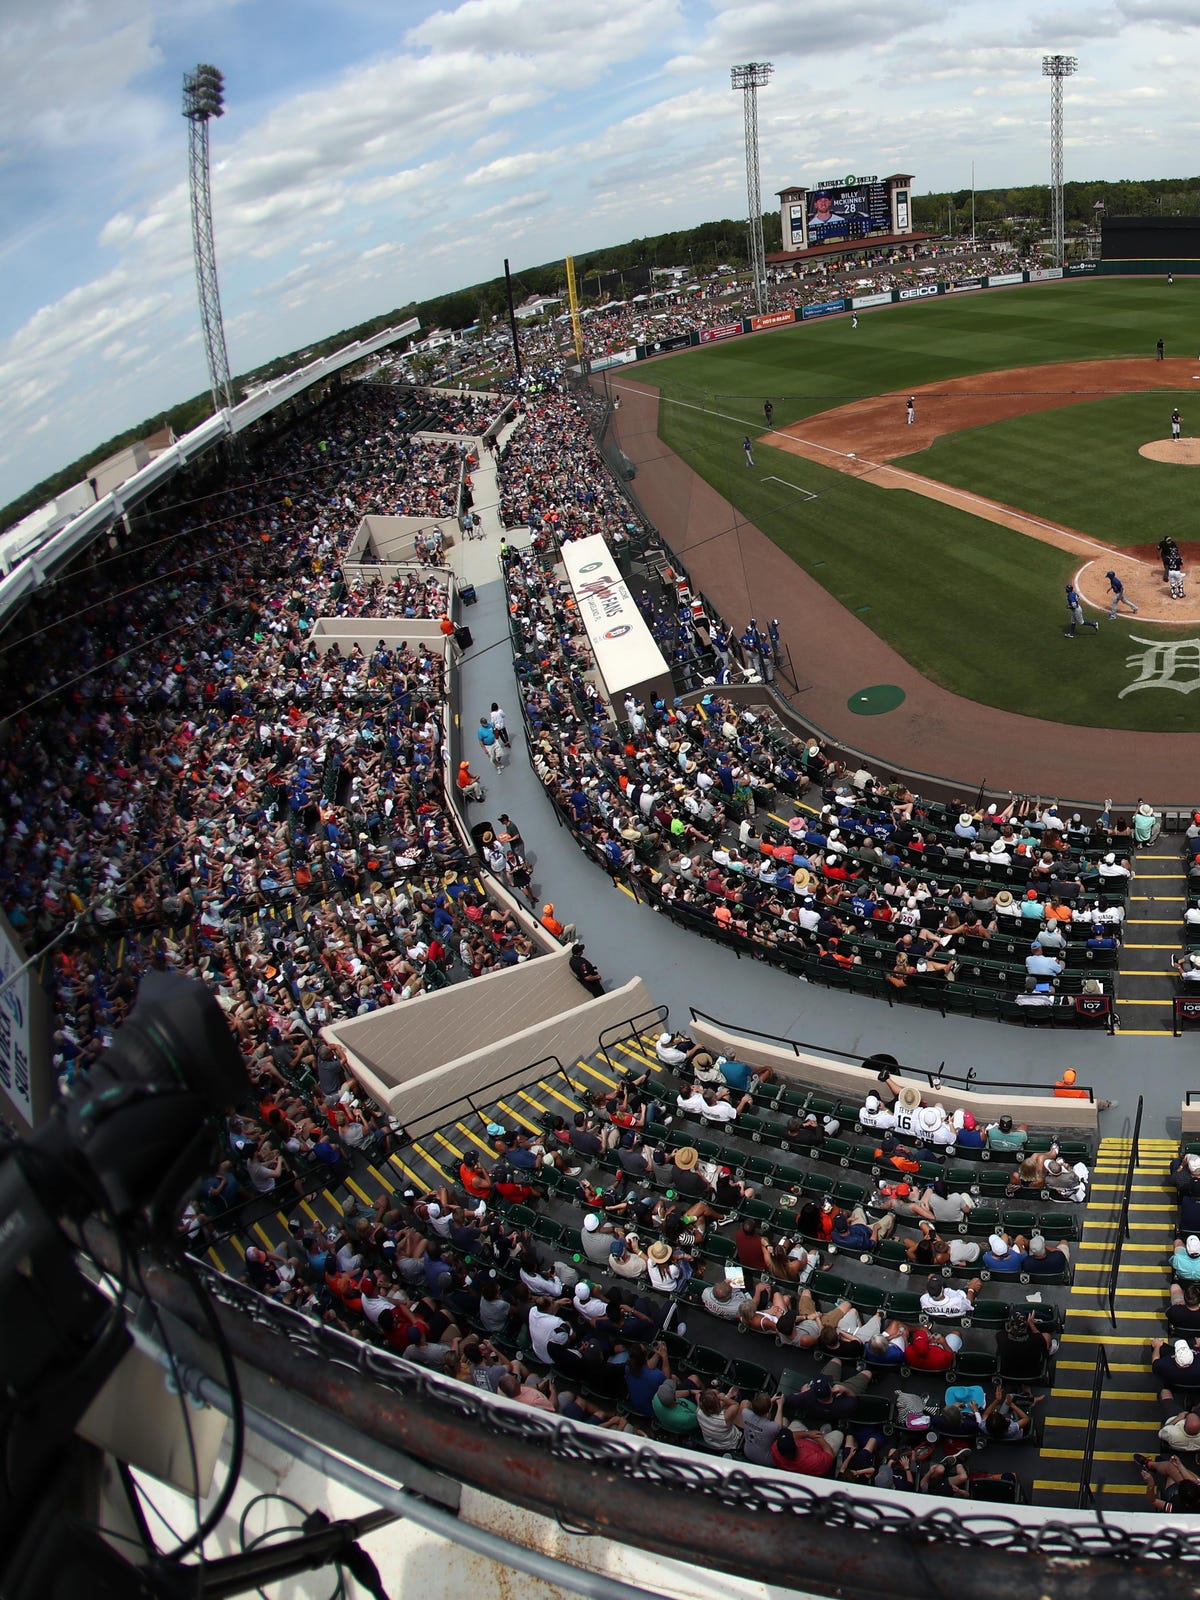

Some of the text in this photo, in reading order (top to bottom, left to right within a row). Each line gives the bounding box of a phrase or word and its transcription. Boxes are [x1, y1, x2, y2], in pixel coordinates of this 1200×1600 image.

[833, 197, 866, 206] MCKINNEY
[844, 204, 856, 214] 28
[899, 286, 938, 299] GEICO
[602, 598, 624, 618] FANS
[902, 914, 913, 924] 20
[1083, 1002, 1101, 1010] 107
[863, 1117, 878, 1126] TETER
[896, 1114, 911, 1130] 16
